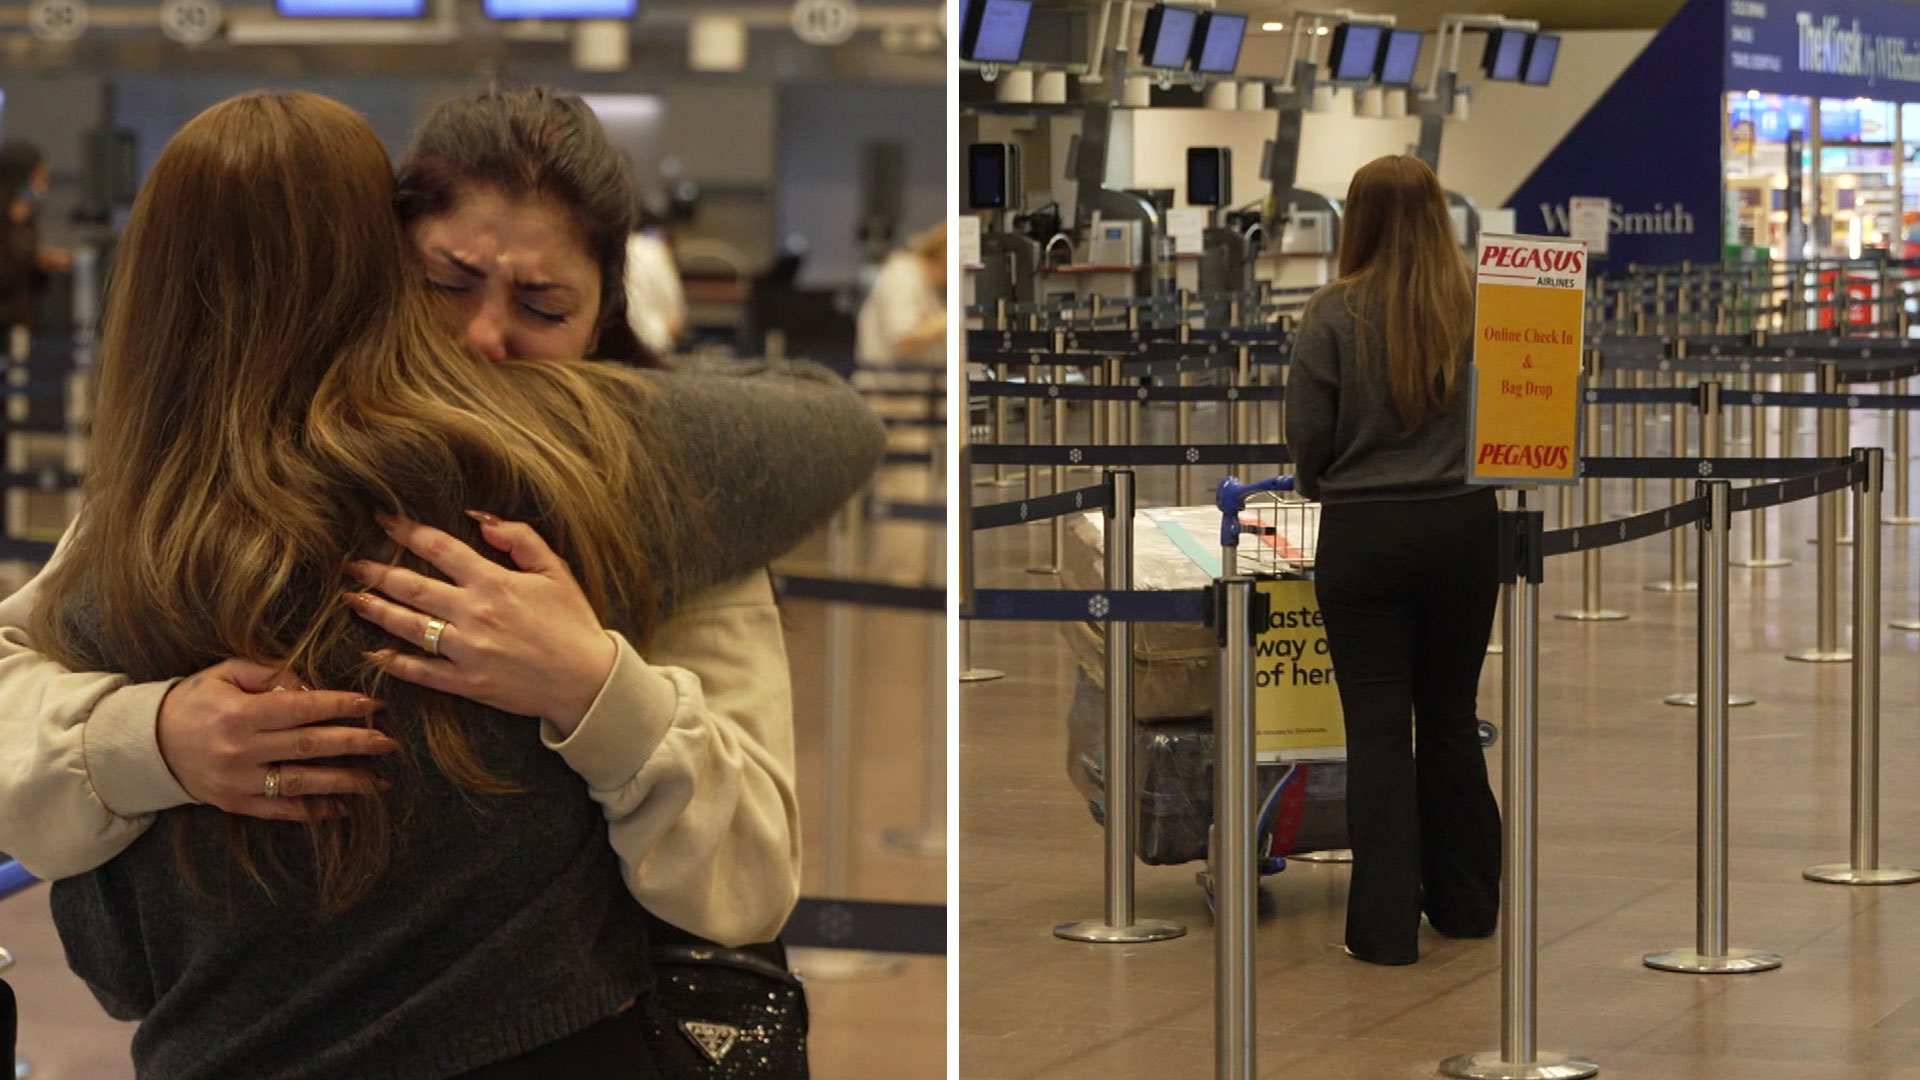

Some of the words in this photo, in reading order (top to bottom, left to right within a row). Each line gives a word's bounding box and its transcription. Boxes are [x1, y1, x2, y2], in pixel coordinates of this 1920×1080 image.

[1540, 202, 1695, 234] WSmith
[1480, 245, 1585, 274] PEGASUS
[1536, 277, 1575, 289] AIRLINES
[1484, 326, 1521, 342] Online
[1524, 328, 1559, 345] Check
[1561, 329, 1574, 345] In
[1522, 354, 1533, 370] &
[1501, 379, 1522, 397] Bag
[1525, 381, 1553, 400] Drop
[1477, 443, 1570, 470] PEGASUS
[1269, 607, 1324, 629] aste
[1256, 639, 1306, 661] way
[1256, 662, 1284, 688] of
[1293, 661, 1336, 686] her
